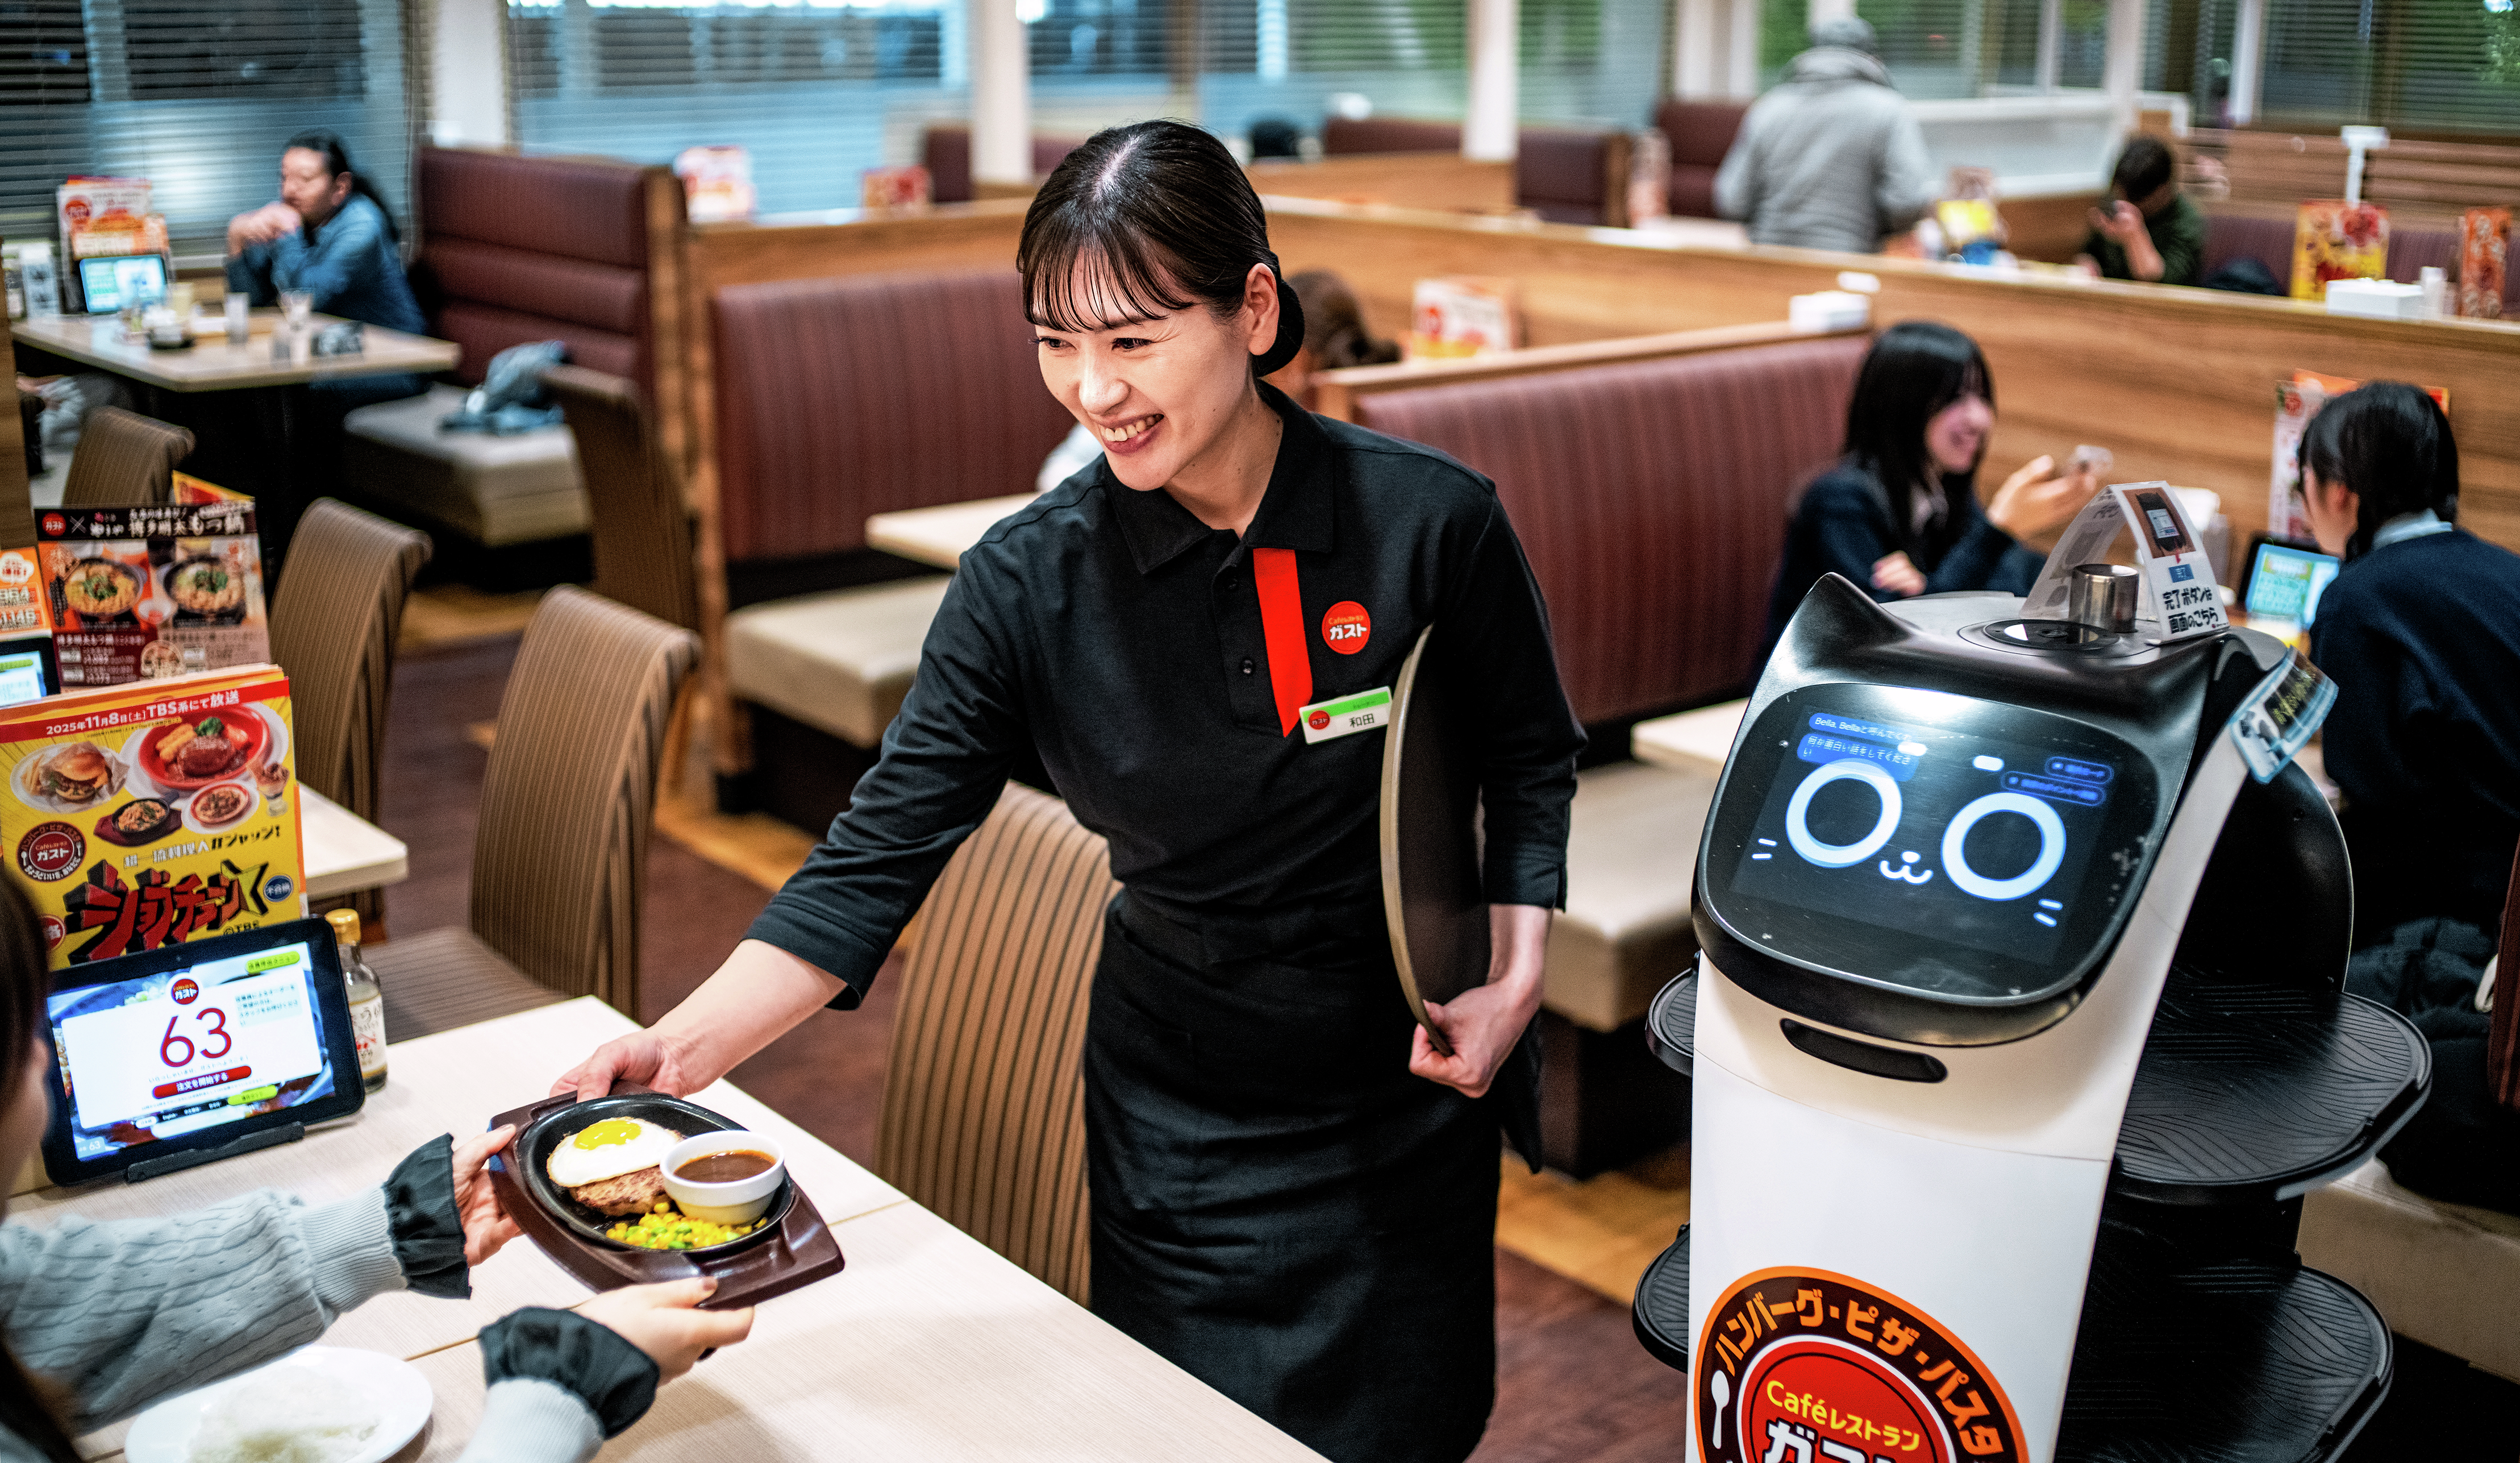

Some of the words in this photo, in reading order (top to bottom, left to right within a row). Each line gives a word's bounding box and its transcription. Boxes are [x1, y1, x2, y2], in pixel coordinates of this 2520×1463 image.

[2162, 586, 2212, 610] 完了ボタンは
[2168, 607, 2218, 634] 画面のこちら
[1330, 623, 1367, 641] ガスト
[1349, 713, 1374, 728] 和田
[37, 848, 69, 862] ガスト
[174, 988, 199, 1001] ガスト
[160, 1008, 232, 1068] 63
[176, 1072, 229, 1092] 注文を開始する
[89, 1140, 101, 1151] 63
[1715, 1289, 2005, 1456] ハンバーグ・ピザ・パスタ
[1767, 1380, 1920, 1451] Caféレストラン
